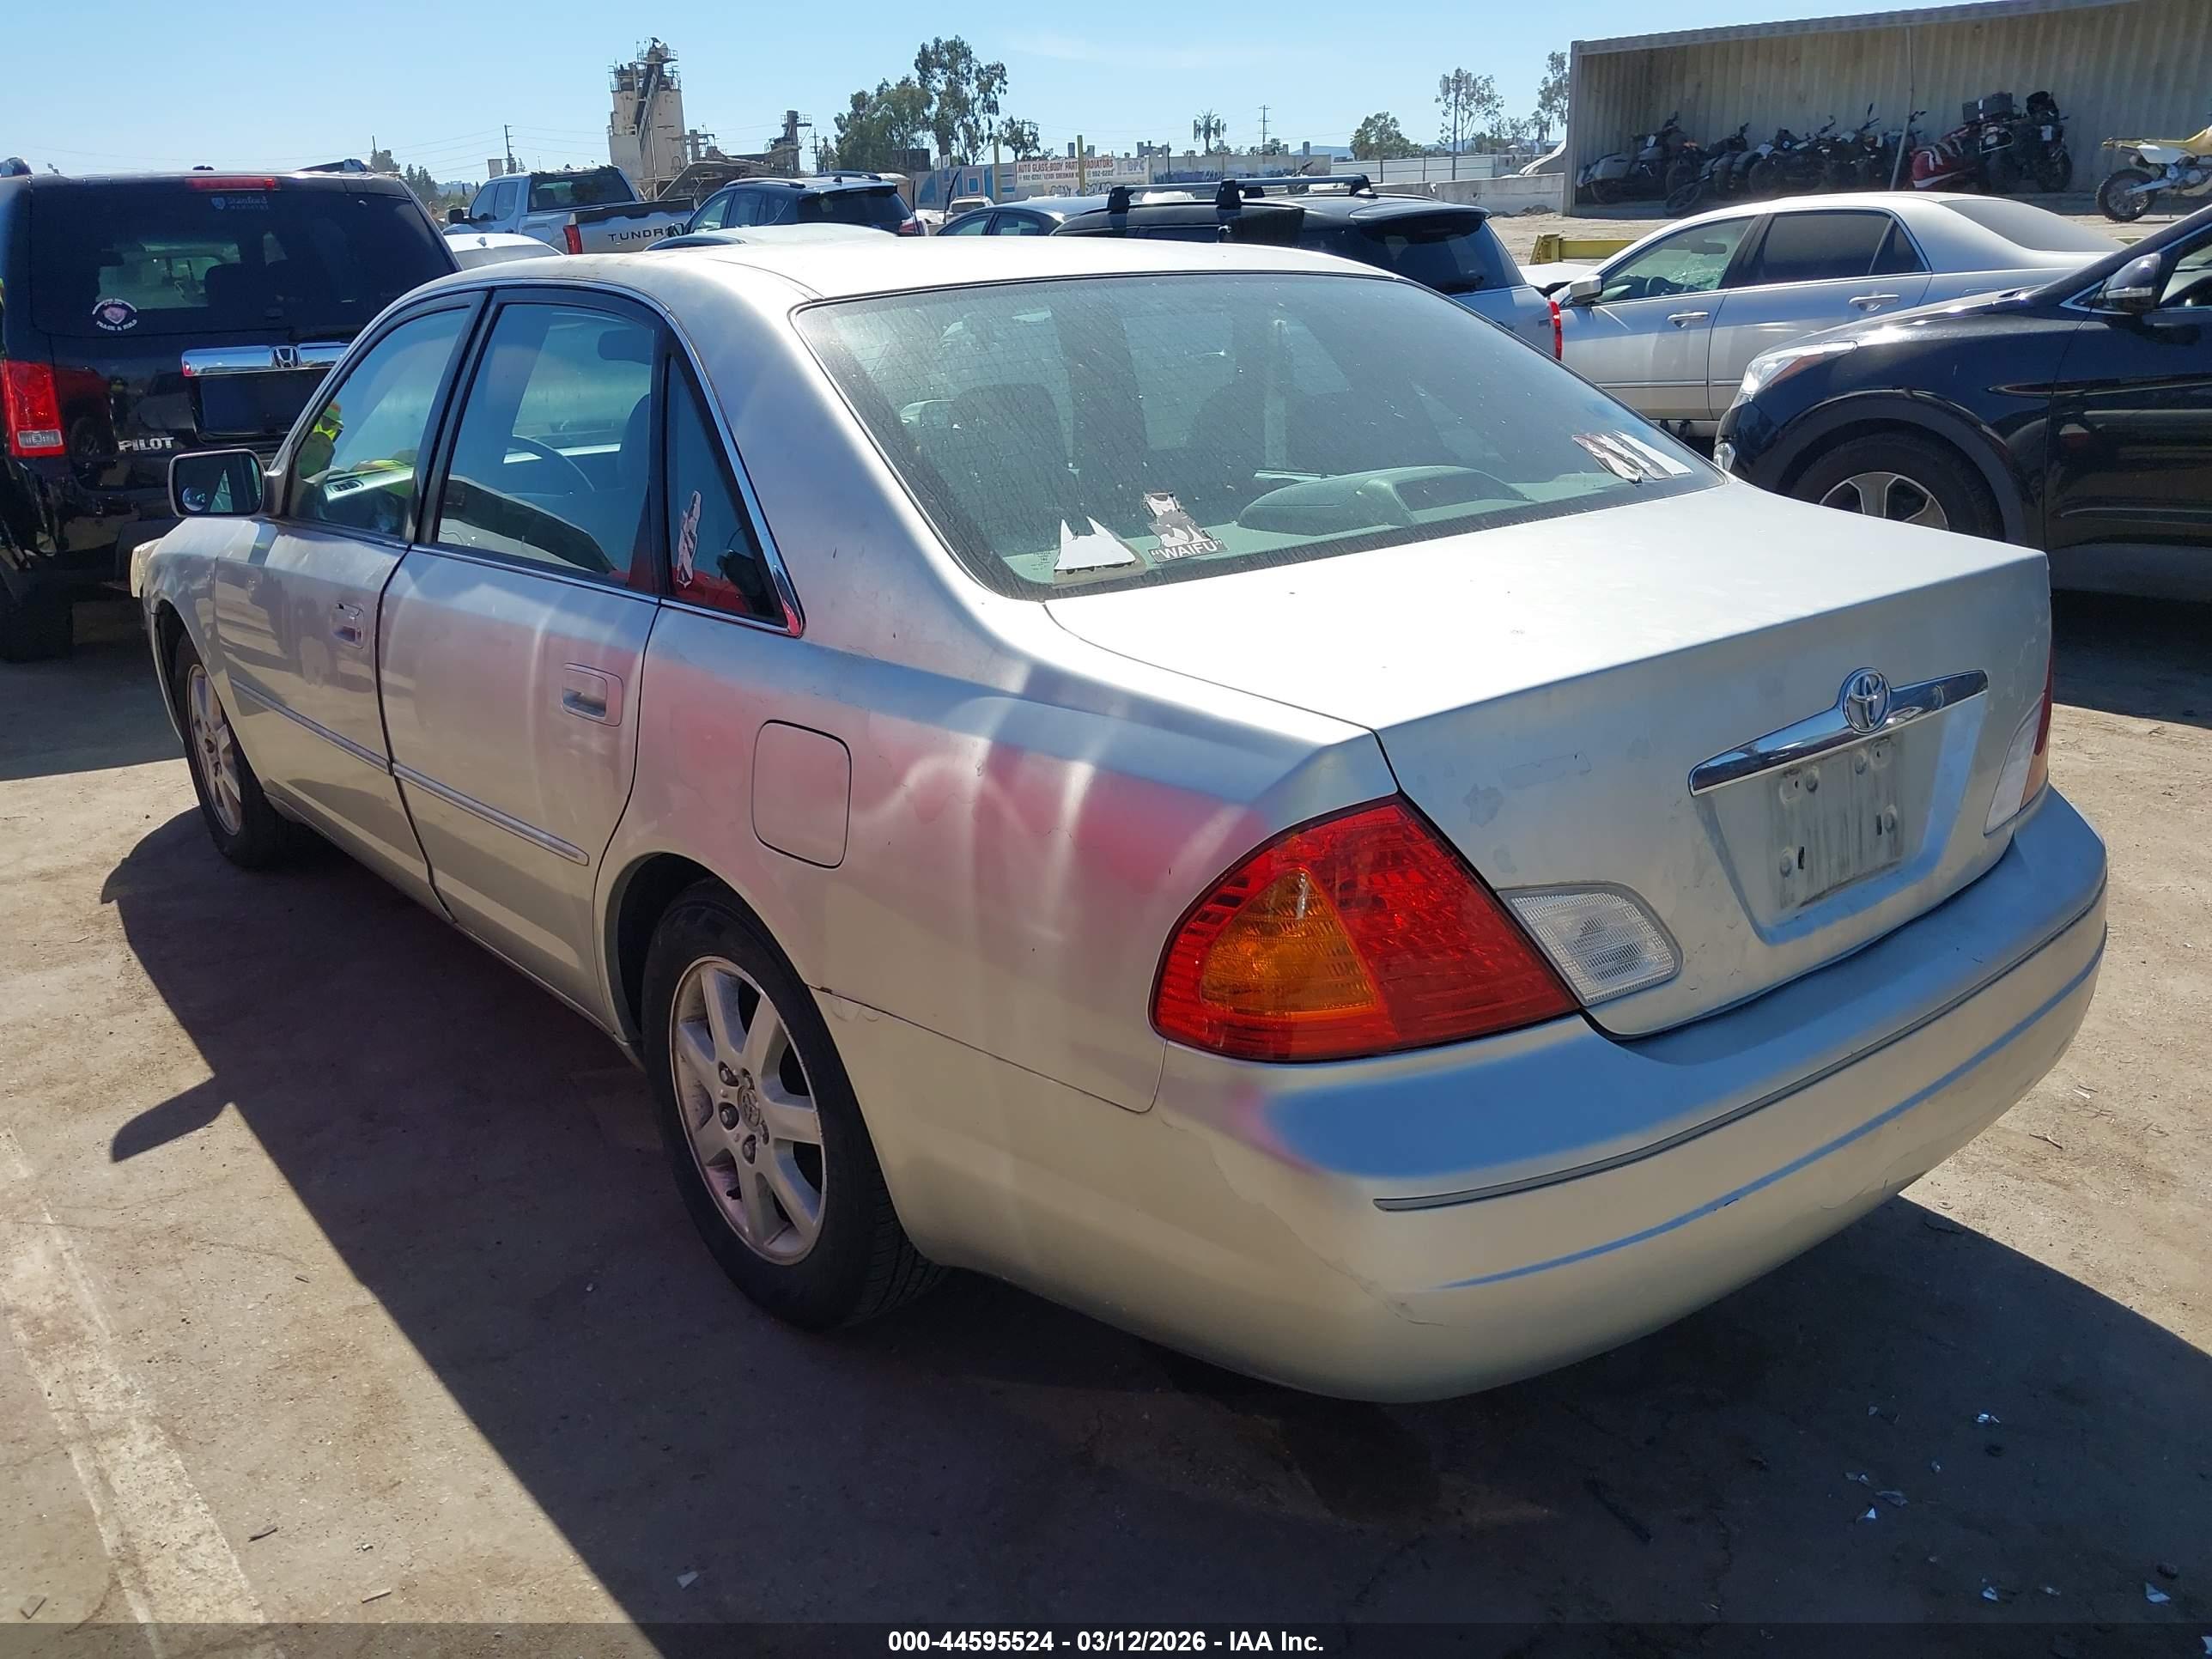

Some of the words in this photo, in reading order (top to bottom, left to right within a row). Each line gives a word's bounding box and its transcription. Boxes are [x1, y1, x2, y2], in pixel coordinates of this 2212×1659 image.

[1018, 163, 1031, 173] AUTO
[608, 228, 666, 241] TUNDR
[118, 437, 174, 452] PILOT
